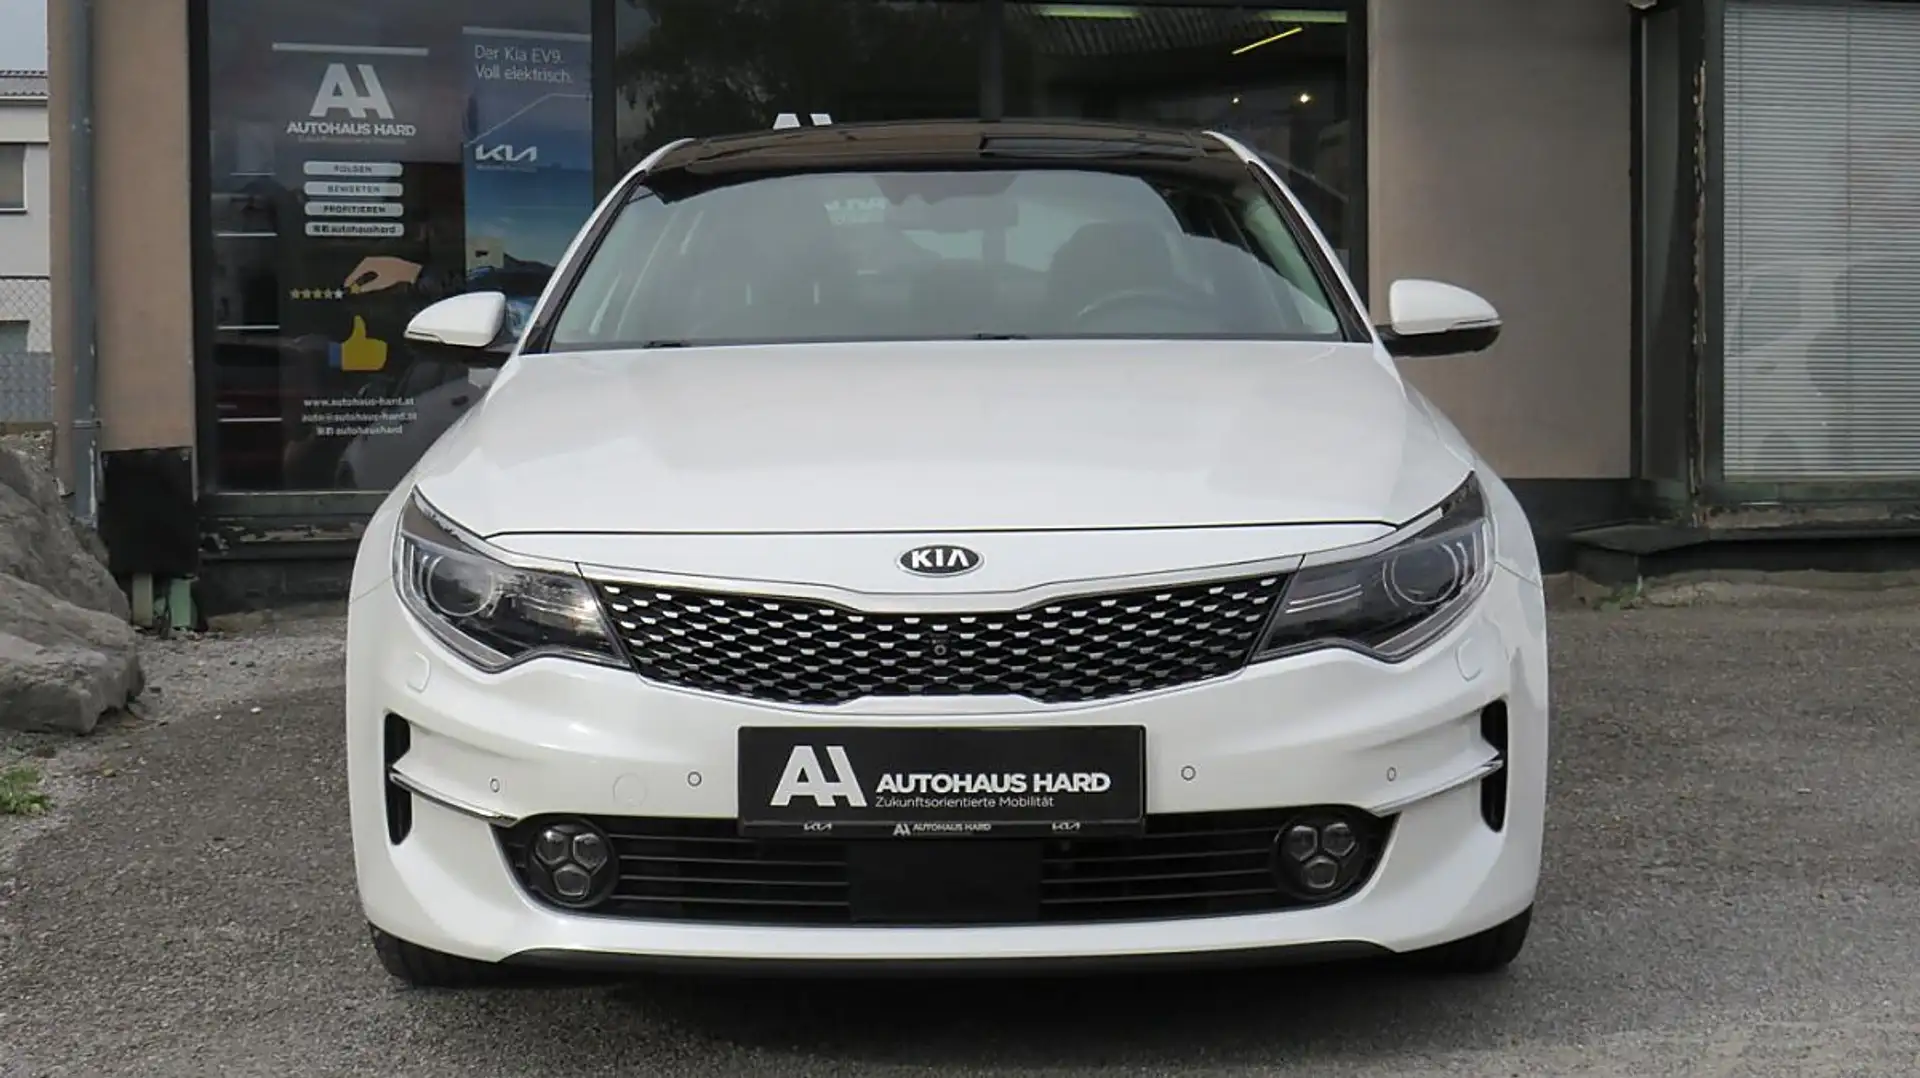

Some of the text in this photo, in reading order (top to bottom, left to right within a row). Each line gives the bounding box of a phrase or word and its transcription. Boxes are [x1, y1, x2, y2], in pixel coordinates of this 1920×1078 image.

[474, 44, 500, 60] Der
[503, 46, 528, 62] Kia
[474, 63, 574, 84] Voll elektrisch.
[286, 121, 417, 137] AUTOHAUS HARD
[323, 204, 387, 214] PROFITIEREN
[331, 224, 396, 234] autohaushard
[911, 548, 970, 569] KIA
[876, 772, 1112, 794] AUTOHAUS HARD
[875, 795, 1055, 808] Zukunftsorientierte Mobilität
[912, 822, 964, 832] AUTOHAUS
[967, 822, 992, 832] HARD
